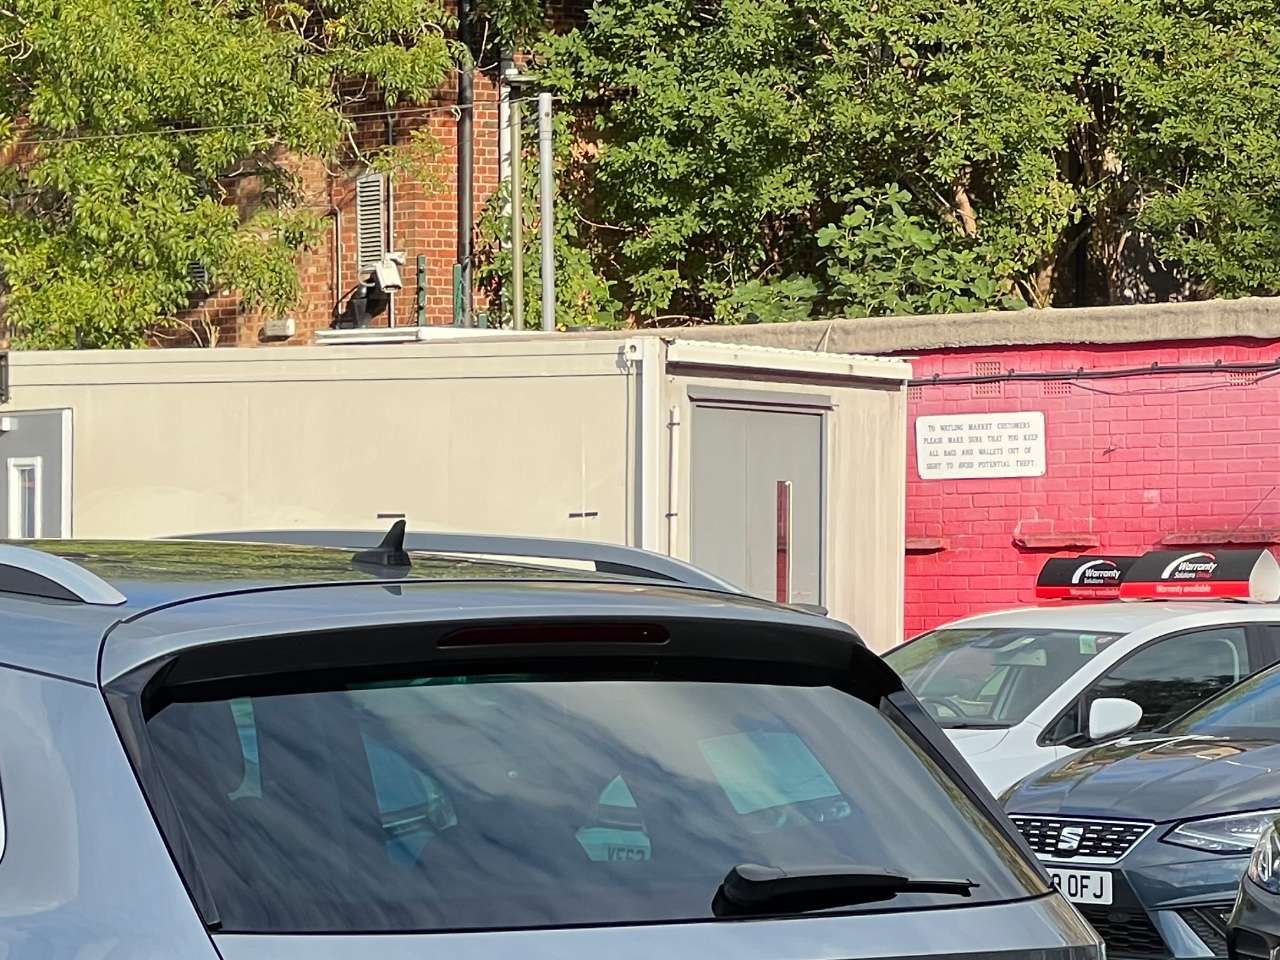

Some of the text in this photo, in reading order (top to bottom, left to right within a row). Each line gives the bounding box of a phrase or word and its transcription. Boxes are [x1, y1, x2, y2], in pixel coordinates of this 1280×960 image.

[1179, 562, 1218, 573] Warranty
[1085, 569, 1121, 580] Warranty
[1156, 583, 1212, 595] Warranty available
[1068, 874, 1103, 898] OFJ
